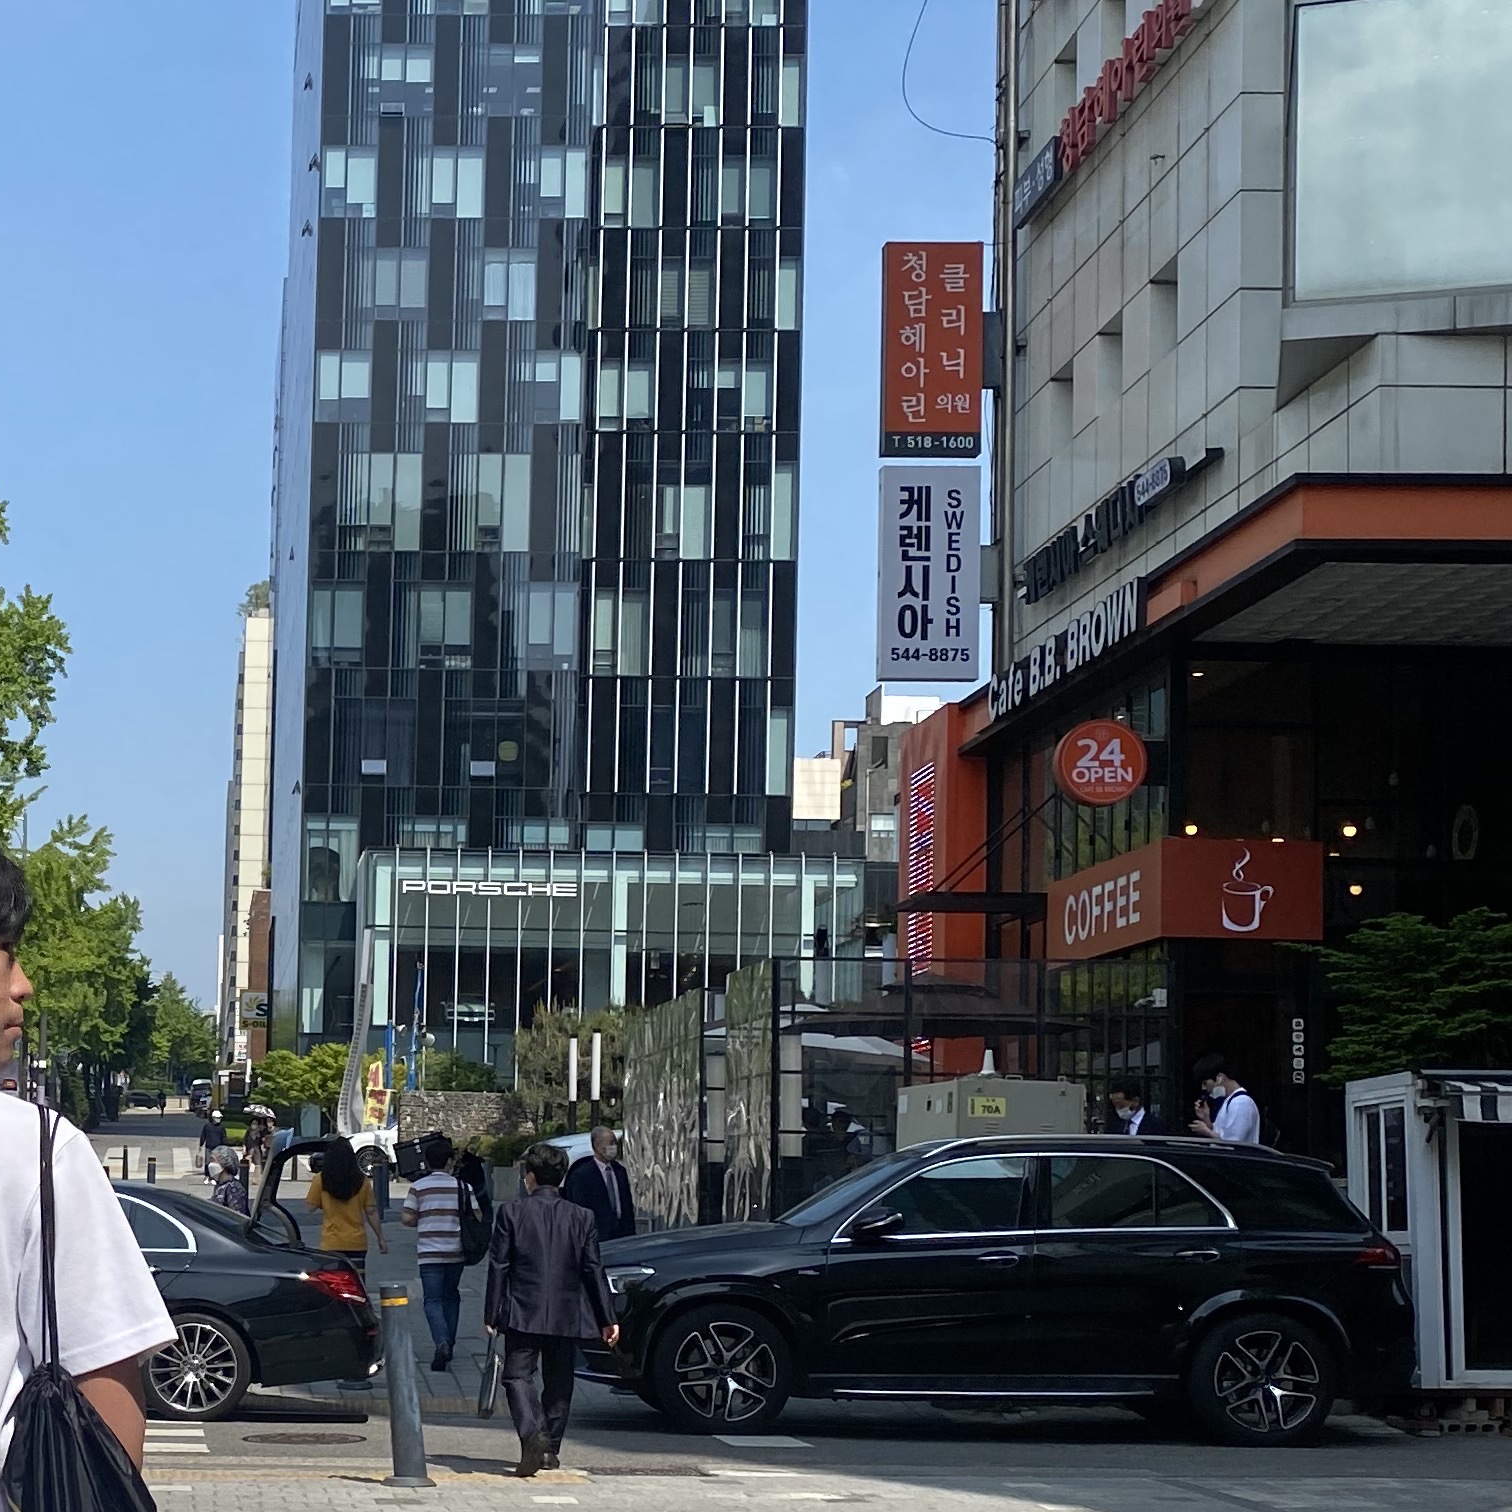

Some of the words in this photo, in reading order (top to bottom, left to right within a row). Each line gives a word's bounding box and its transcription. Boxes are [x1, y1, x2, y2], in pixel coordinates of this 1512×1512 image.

[899, 251, 933, 424] 청담헤아린
[939, 263, 970, 380] 클리닉
[935, 393, 971, 414] 의원
[907, 436, 974, 449] 518-1600
[897, 485, 934, 641] 케렌시아
[944, 489, 965, 638] SWEDISH
[891, 647, 970, 662] 544-8875
[989, 662, 1023, 722] Cafe
[1067, 577, 1138, 673] BROWN
[1072, 767, 1134, 783] OPEN
[1076, 738, 1126, 767] 24
[402, 880, 577, 897] PORSCHE
[1065, 870, 1140, 945] COFFEE
